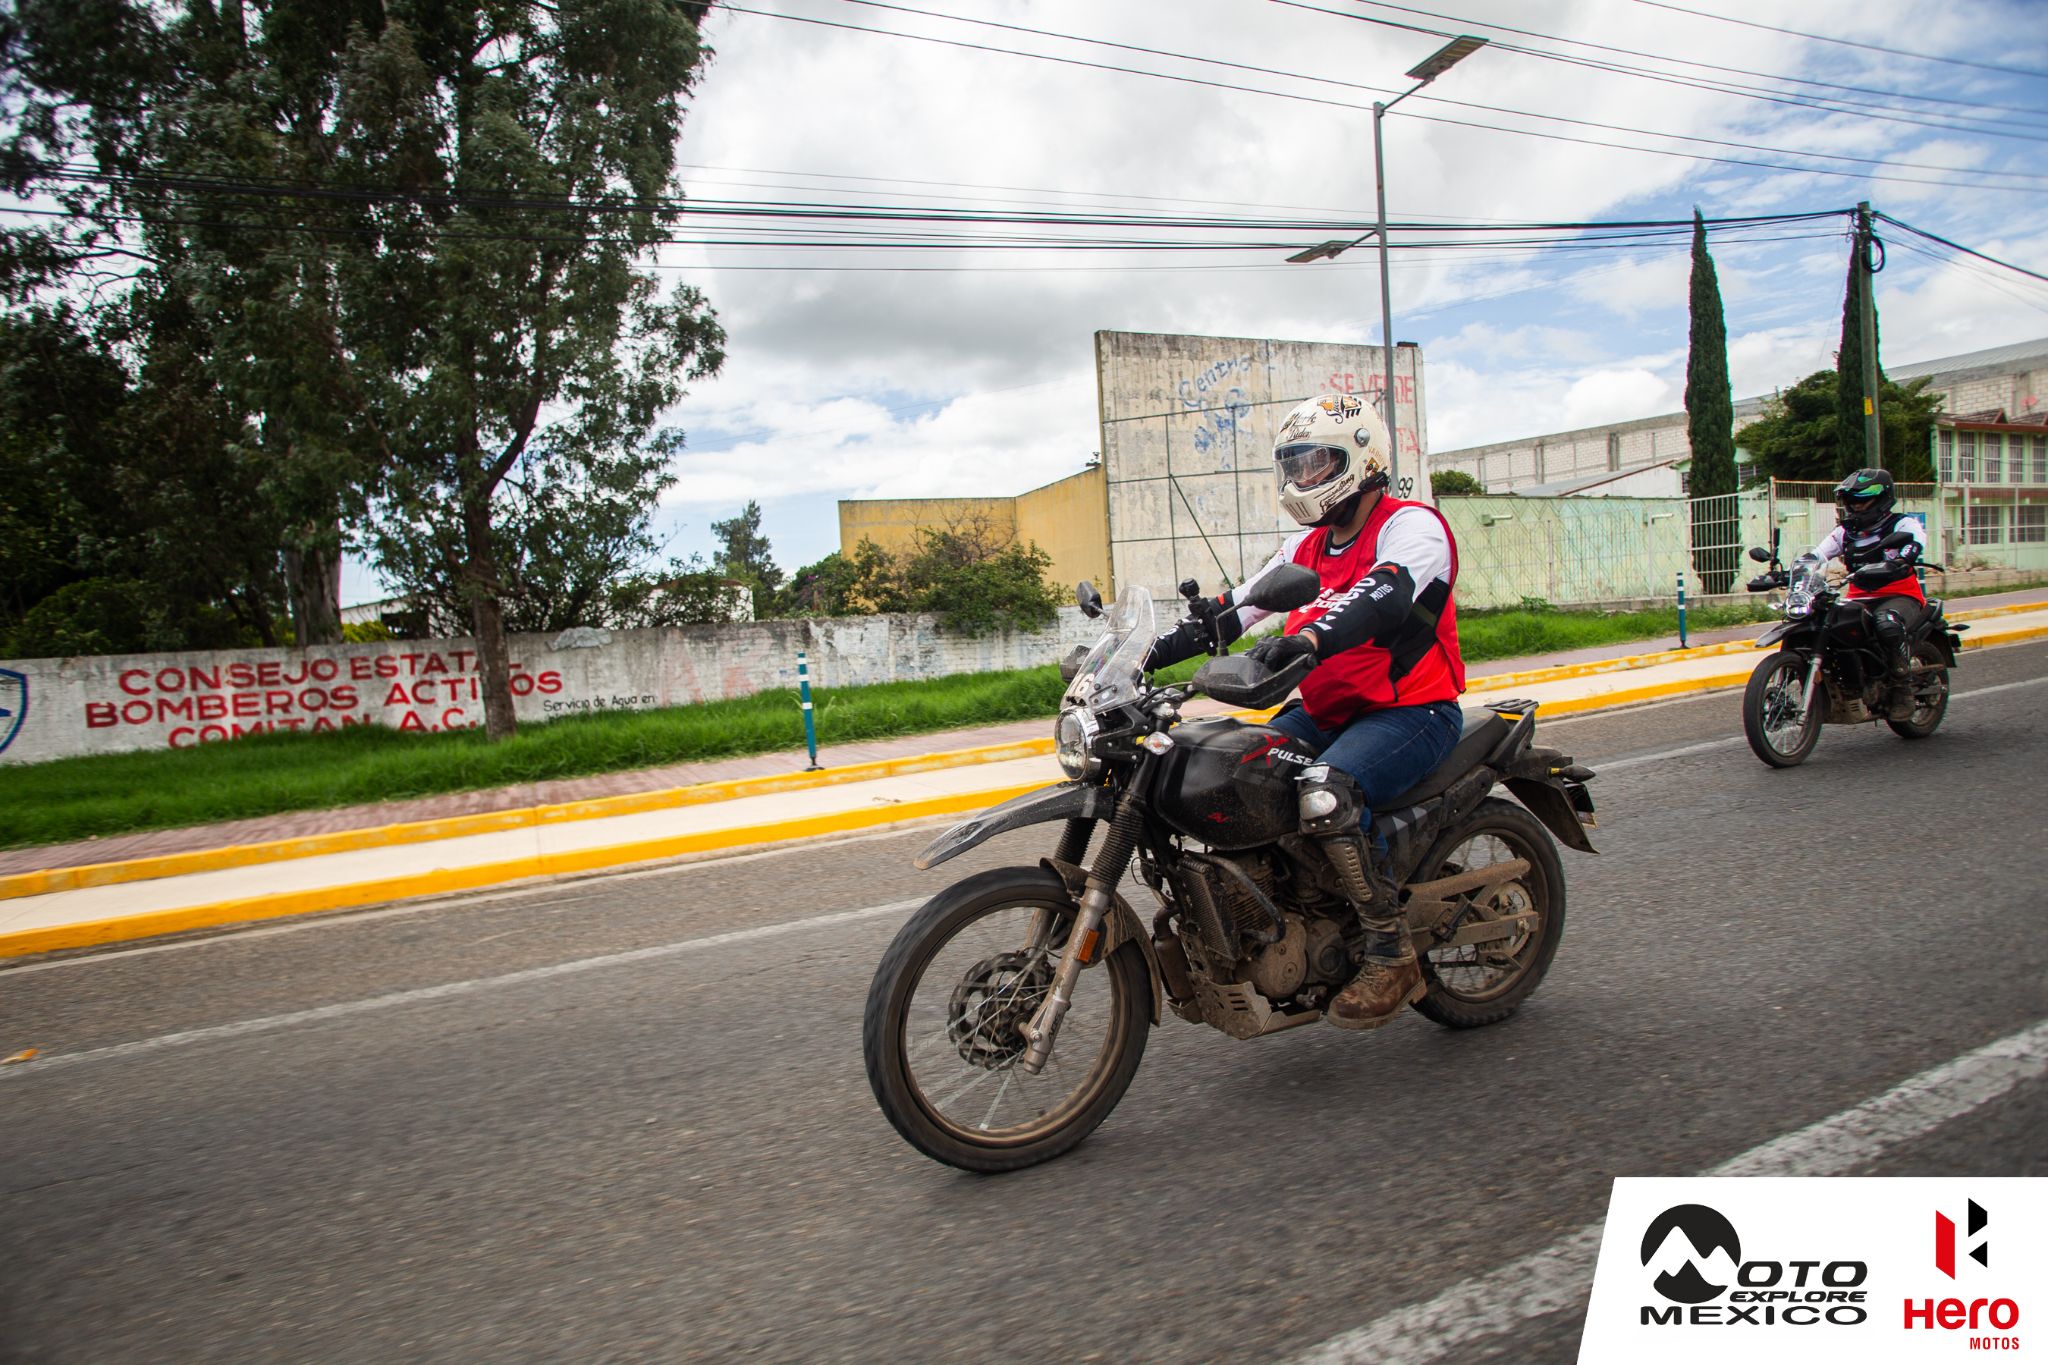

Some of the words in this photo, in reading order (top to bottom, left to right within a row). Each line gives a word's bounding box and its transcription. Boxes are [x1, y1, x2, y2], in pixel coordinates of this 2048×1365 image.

[1369, 583, 1394, 602] MOTOS
[118, 658, 339, 696] CONSEJO
[350, 651, 522, 681] ESTAT
[85, 685, 359, 729] BOMBEROS
[384, 671, 562, 707] ACTIOS
[543, 698, 591, 713] Servicio
[593, 694, 606, 708] de
[611, 695, 638, 709] Agua
[641, 694, 656, 704] en
